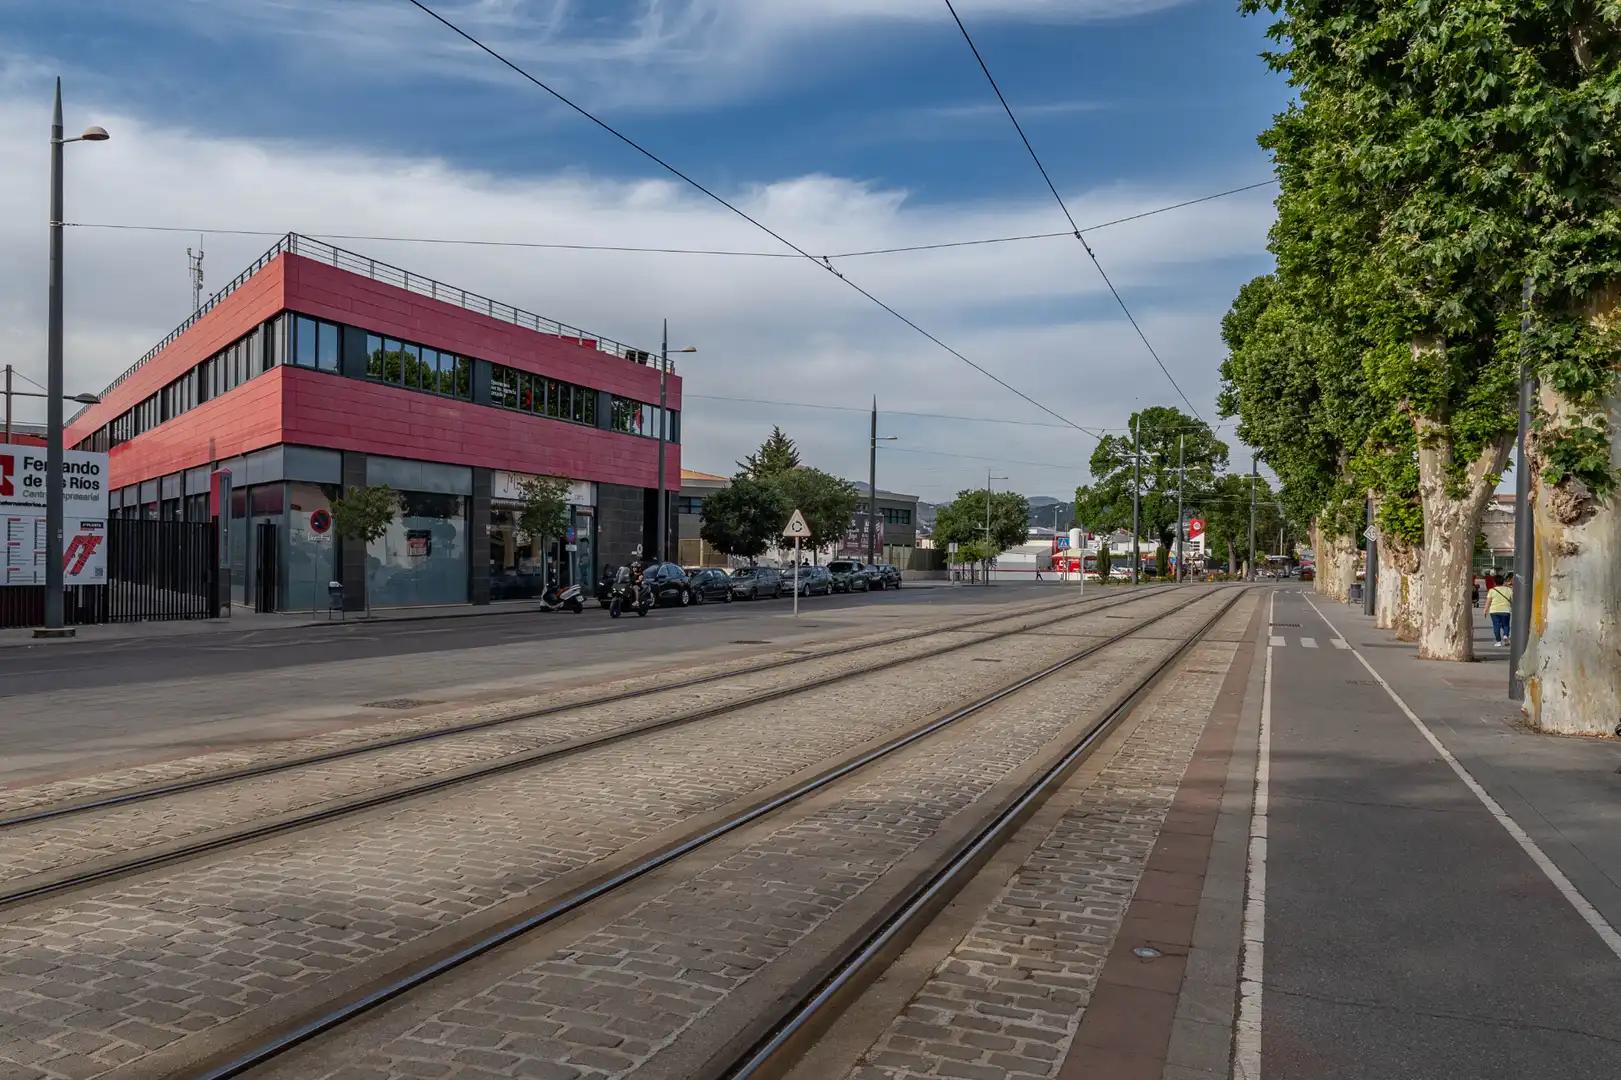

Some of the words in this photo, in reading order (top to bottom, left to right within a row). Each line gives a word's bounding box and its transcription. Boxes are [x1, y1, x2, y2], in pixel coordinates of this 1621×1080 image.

[23, 456, 100, 476] Ferando
[23, 474, 42, 487] de
[69, 476, 100, 490] Ríos
[22, 489, 46, 498] Centr
